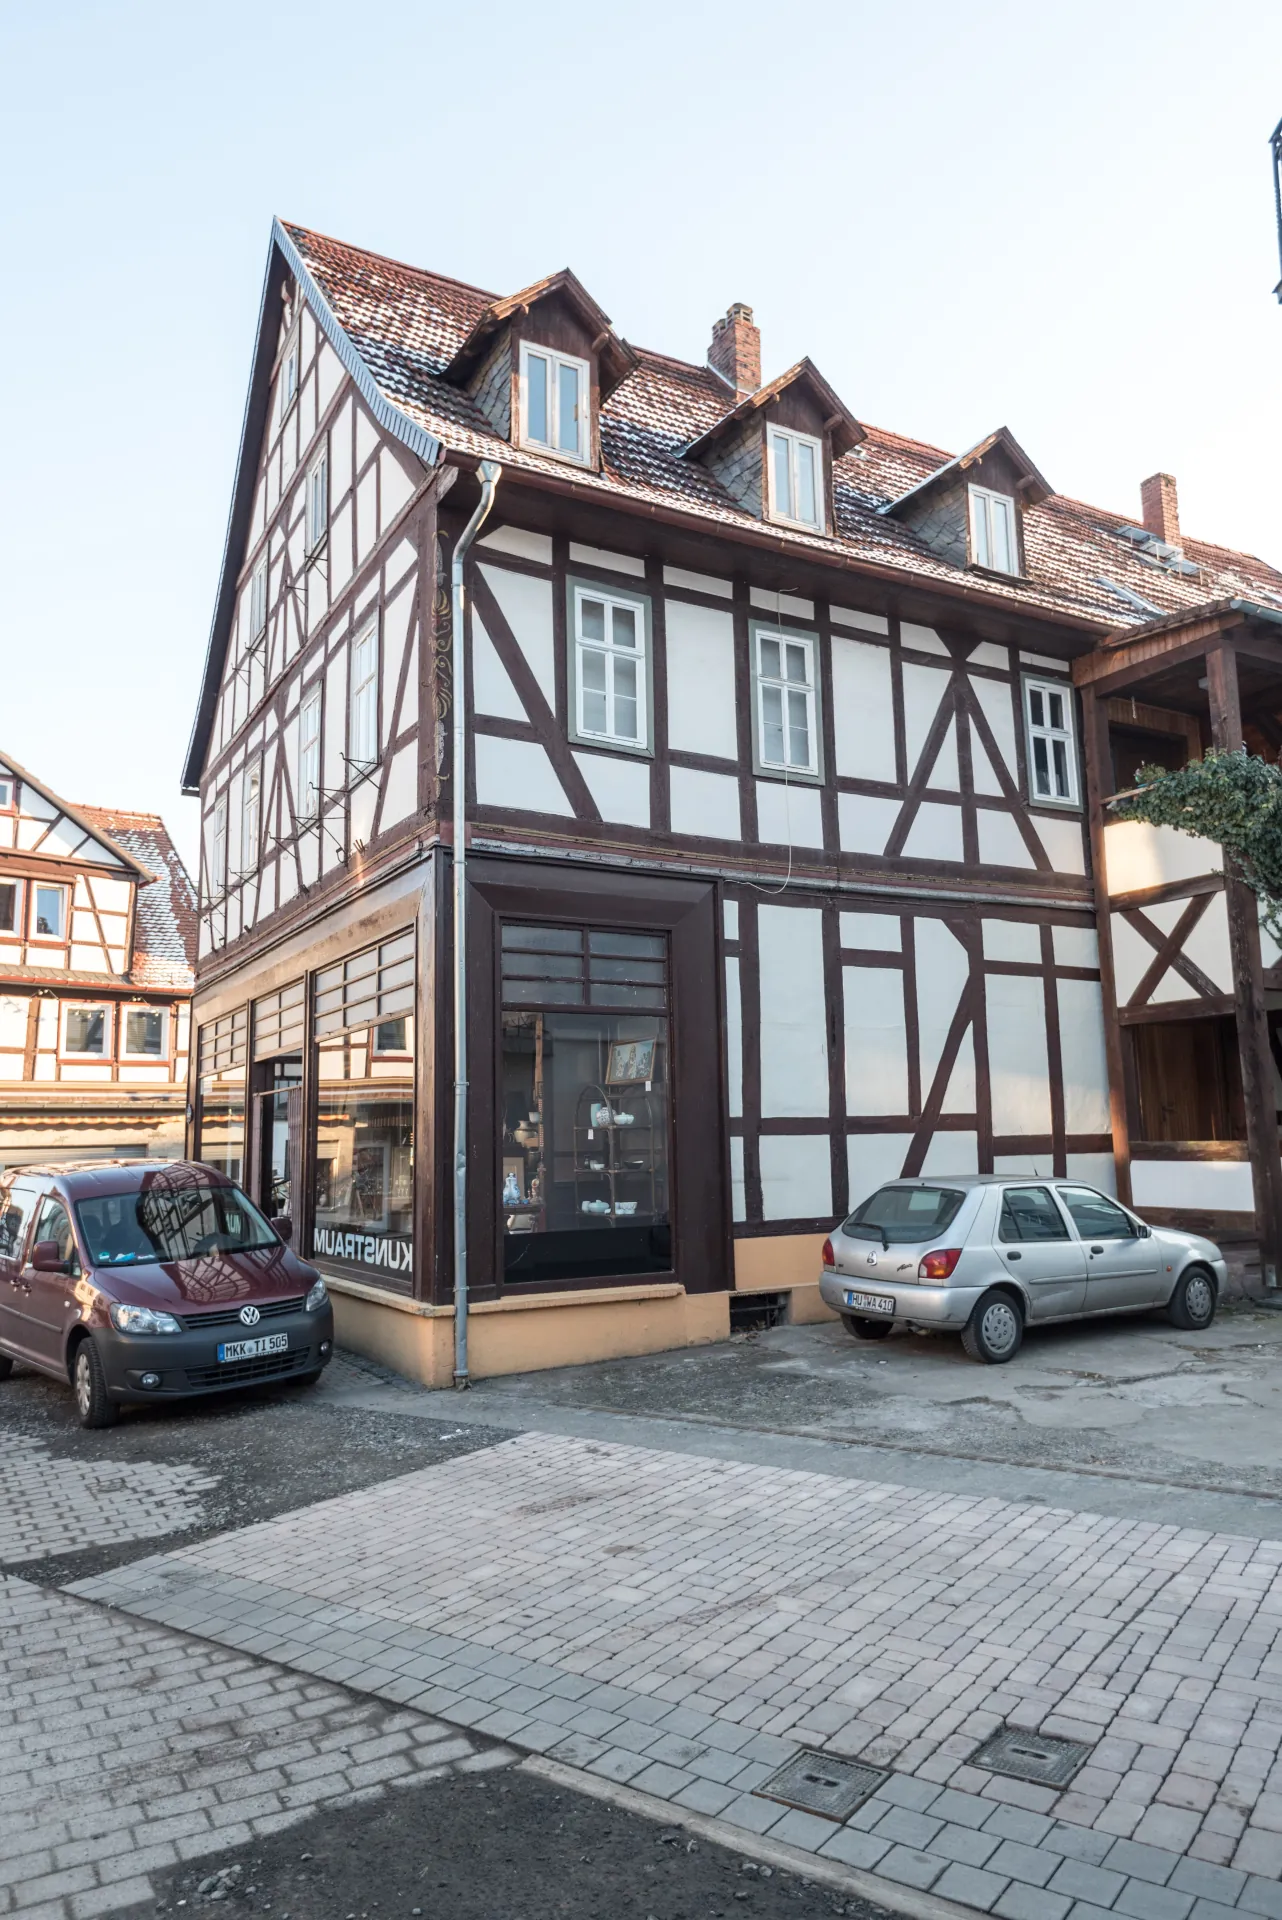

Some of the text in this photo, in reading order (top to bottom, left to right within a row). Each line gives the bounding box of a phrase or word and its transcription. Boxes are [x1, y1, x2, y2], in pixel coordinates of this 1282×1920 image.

[853, 1294, 863, 1306] HU
[878, 1298, 893, 1311] 410
[225, 1342, 246, 1358] MKK
[254, 1339, 267, 1352] TI
[269, 1335, 287, 1350] 505
